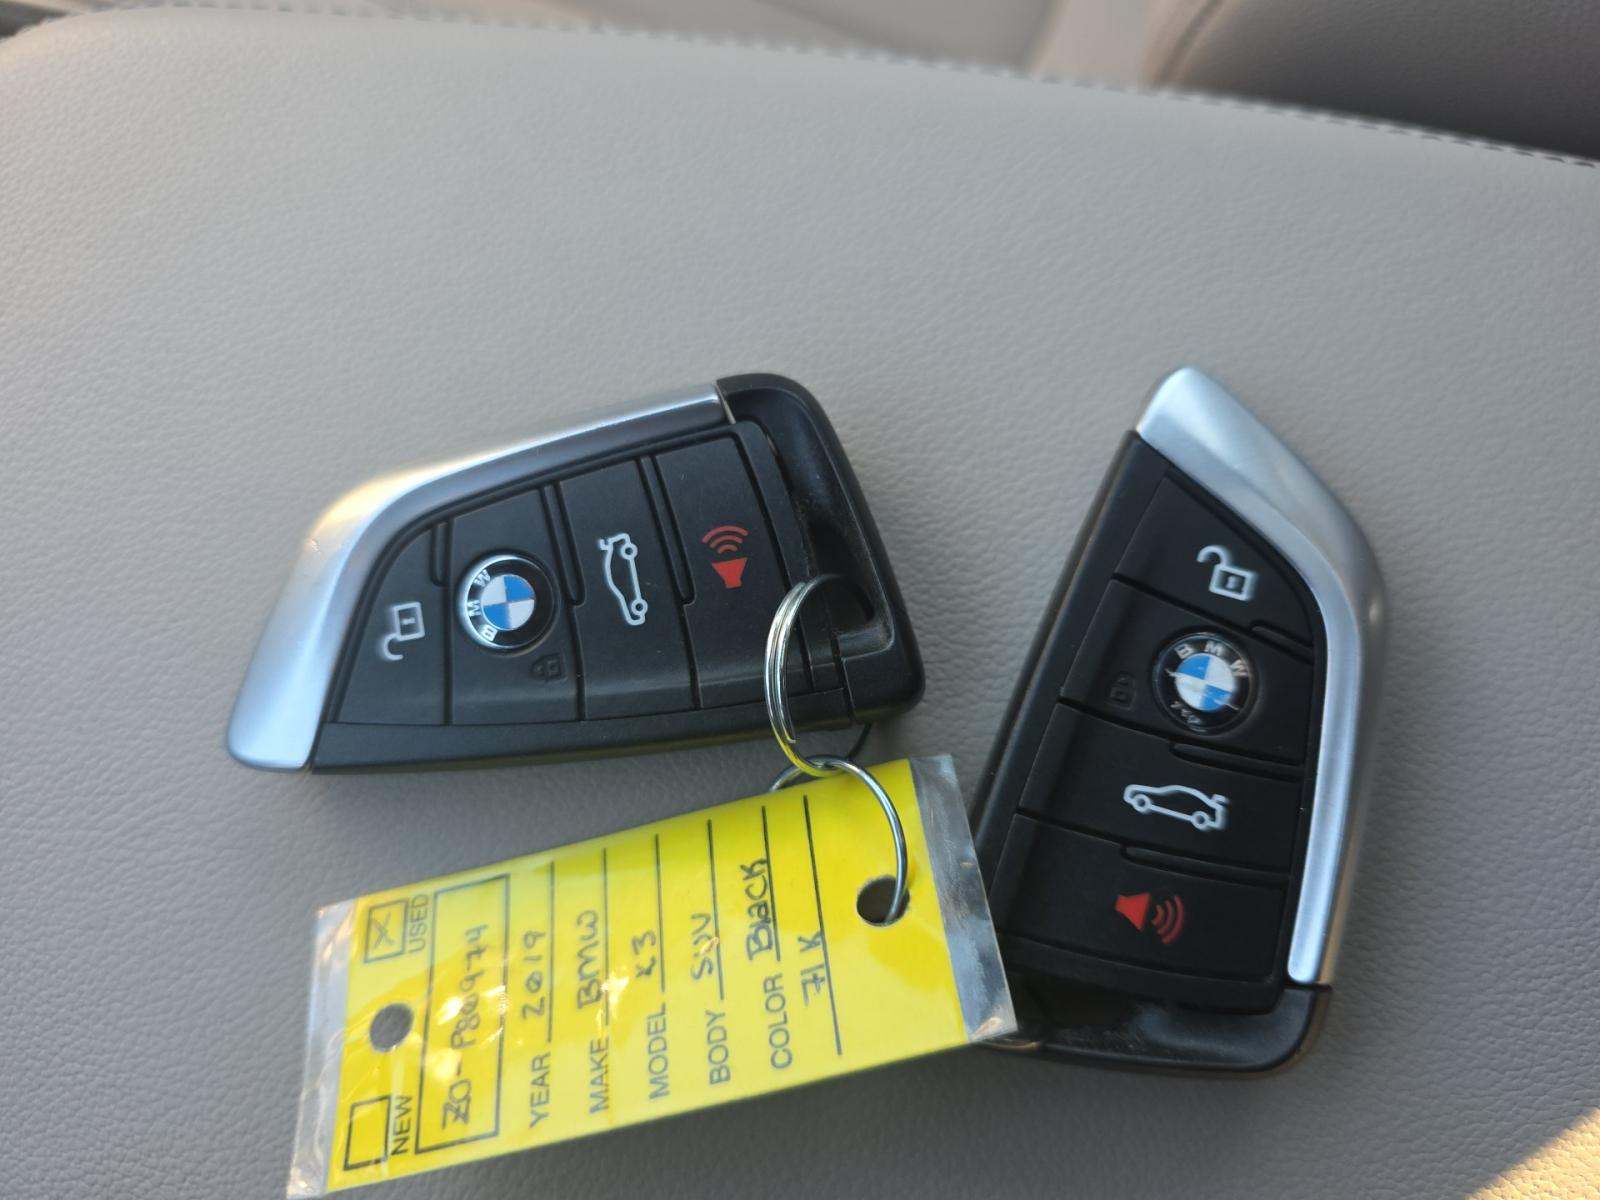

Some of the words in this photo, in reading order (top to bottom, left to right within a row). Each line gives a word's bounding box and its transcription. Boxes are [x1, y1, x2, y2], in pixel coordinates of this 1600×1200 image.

[467, 569, 498, 641] BMW
[1174, 640, 1248, 677] BMW
[407, 893, 430, 955] USED
[520, 930, 547, 1022] 2019
[648, 1002, 670, 1100] MODEL
[704, 1008, 731, 1085] BODY
[762, 972, 793, 1071] COLOR
[528, 1051, 551, 1128] YEAR
[588, 1036, 609, 1115] MAKE
[388, 1094, 413, 1155] NEW
